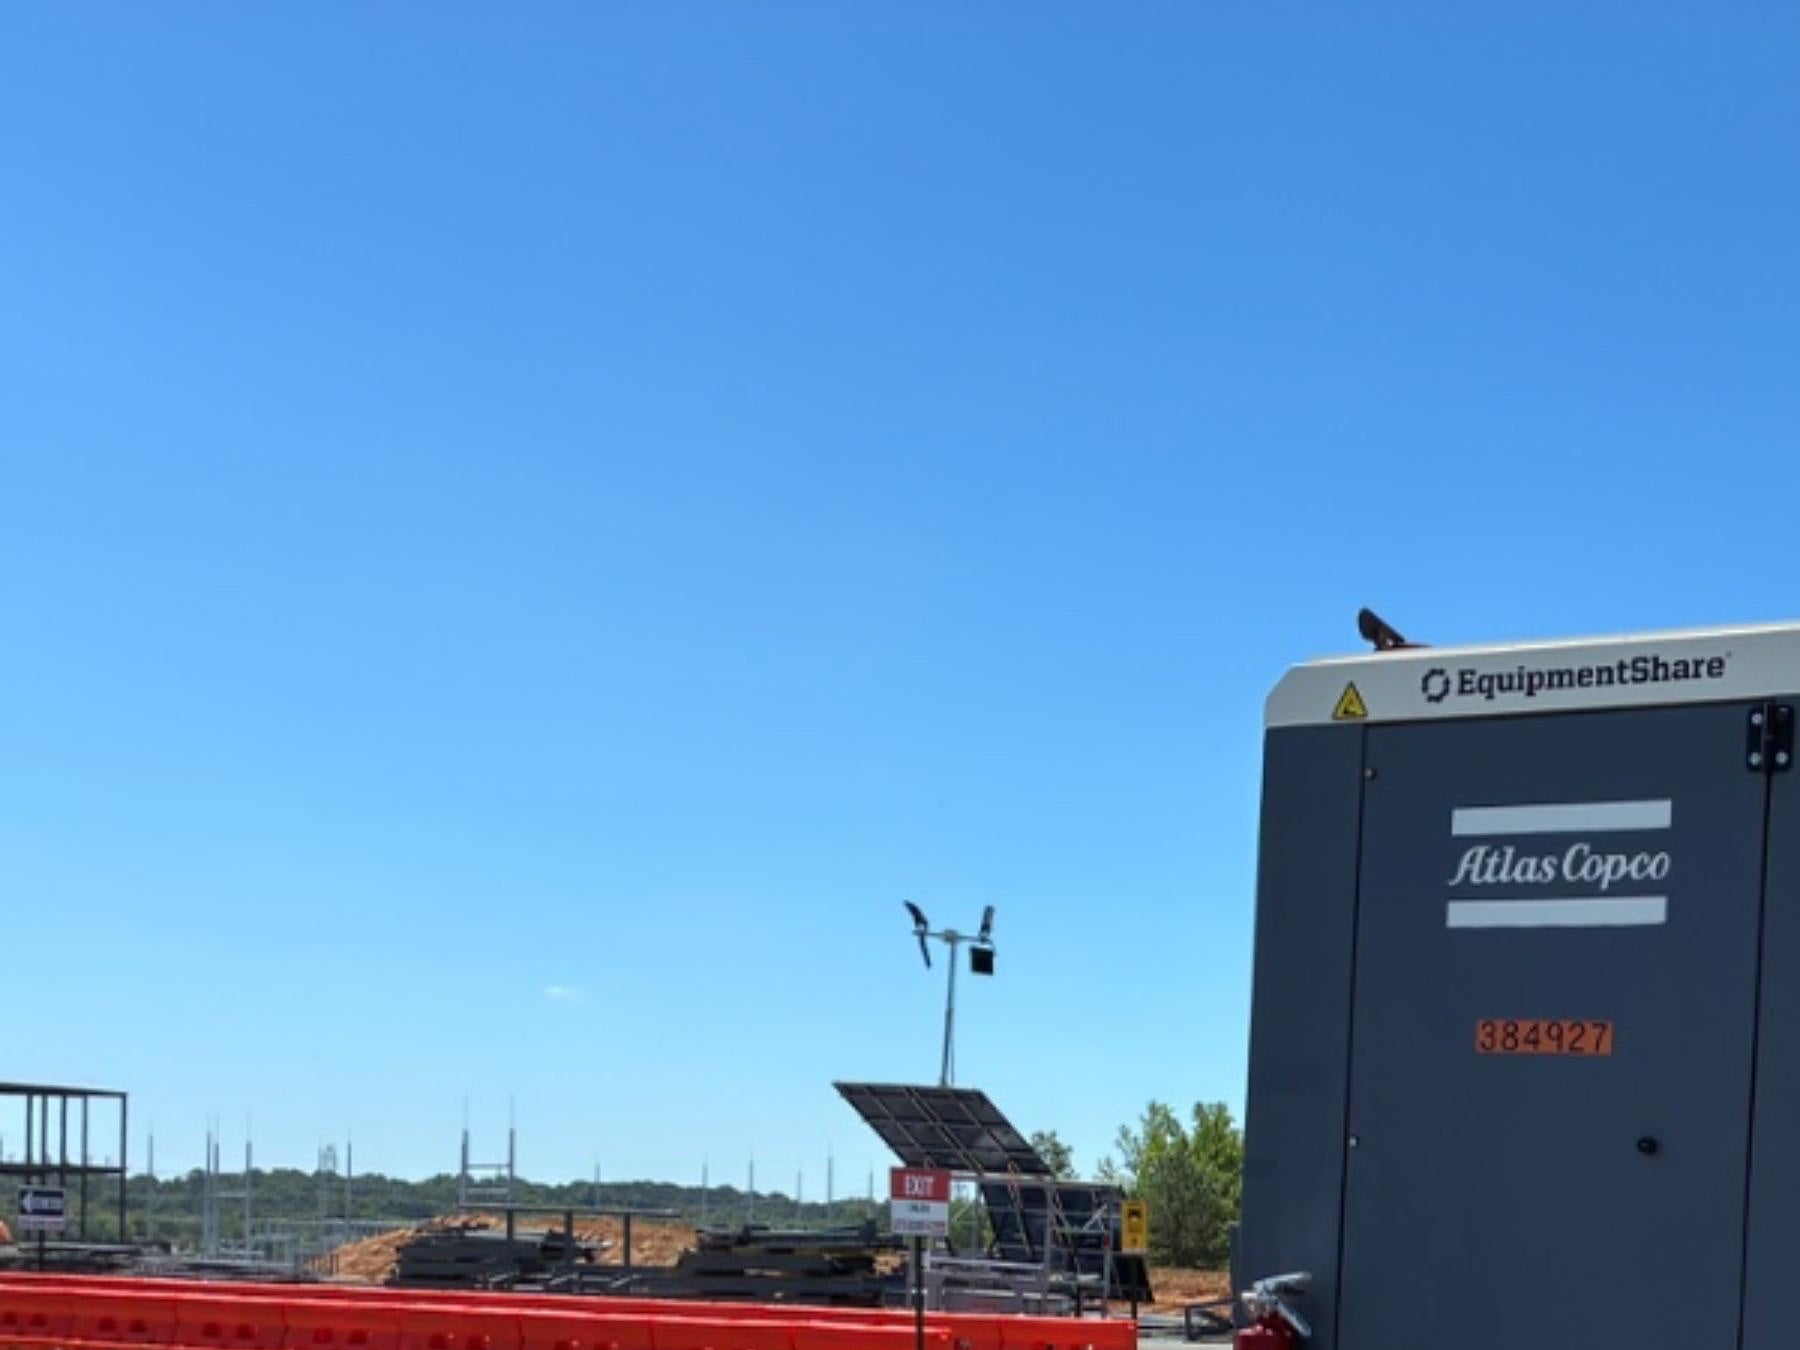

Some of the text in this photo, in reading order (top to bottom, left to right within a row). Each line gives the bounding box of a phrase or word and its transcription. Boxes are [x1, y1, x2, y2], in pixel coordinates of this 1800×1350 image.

[1457, 655, 1726, 700] EquipmentShare
[1449, 843, 1670, 891] Atlas Copco
[1479, 1020, 1608, 1052] 384927
[905, 1175, 934, 1195] EXIT
